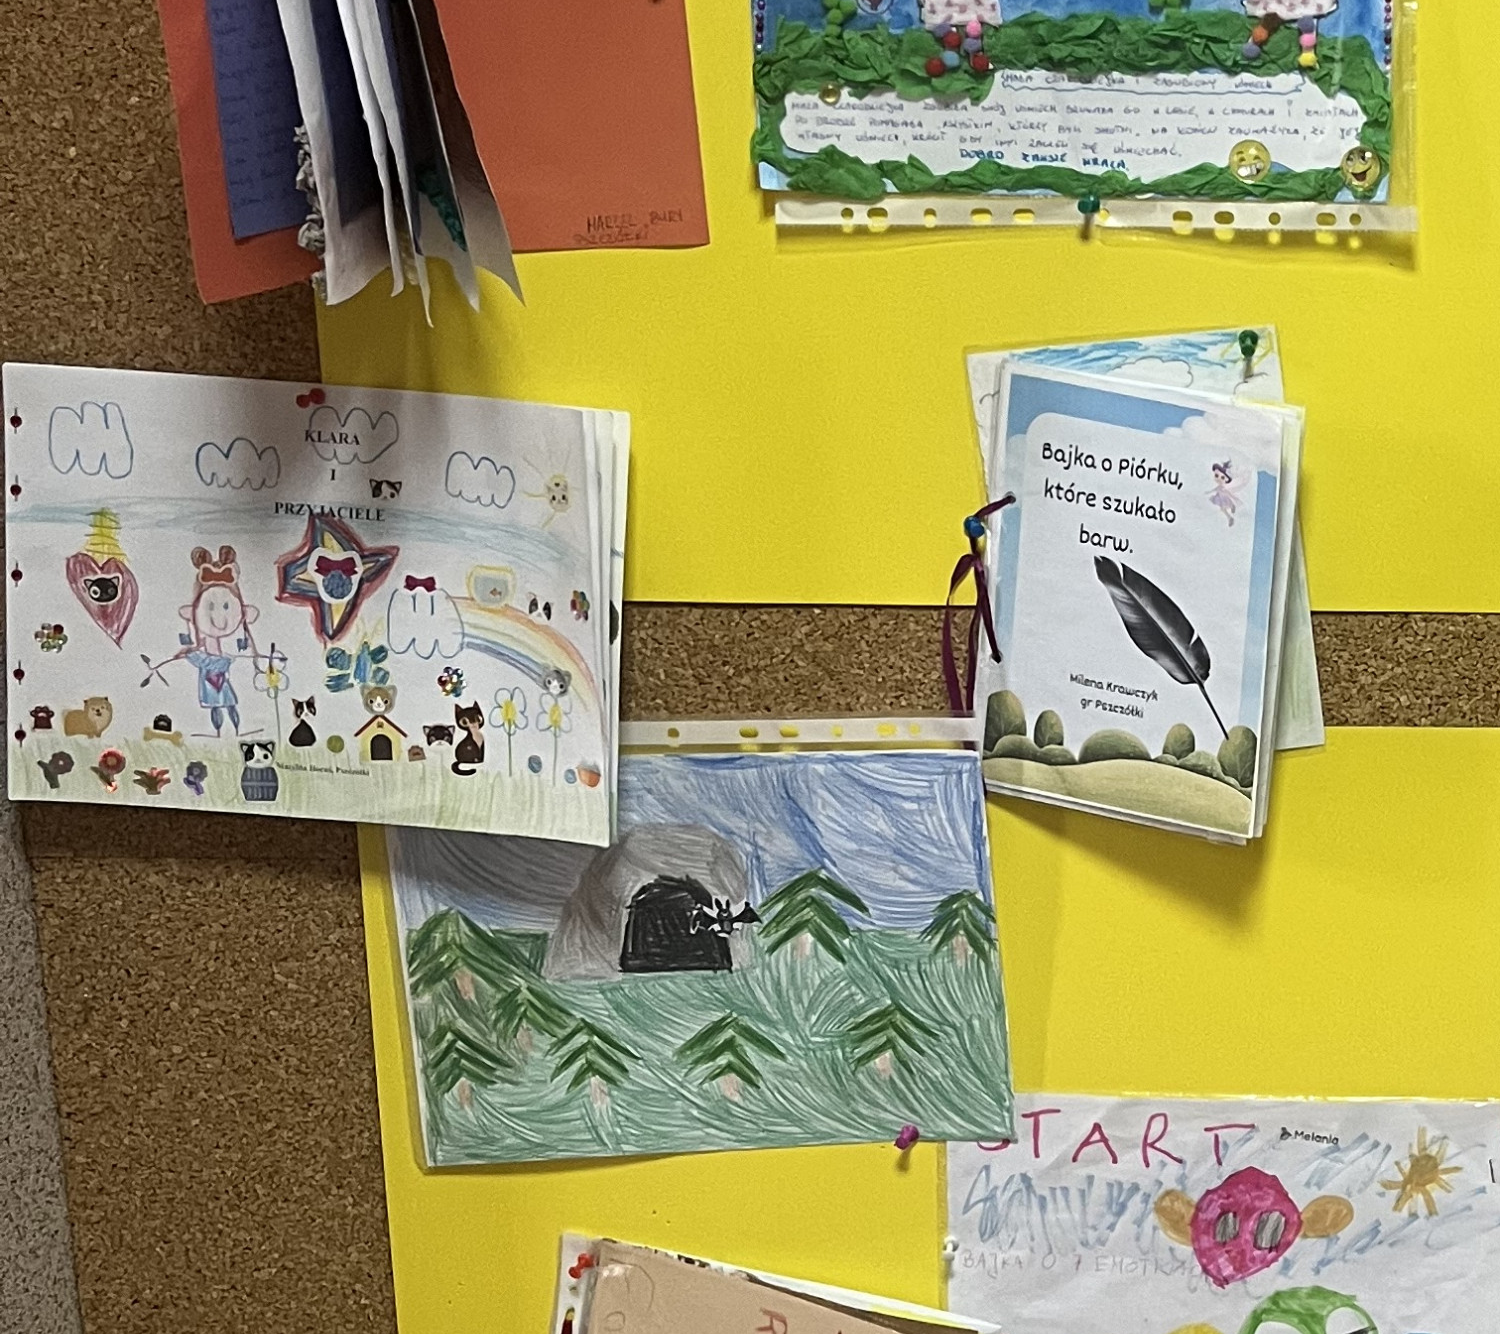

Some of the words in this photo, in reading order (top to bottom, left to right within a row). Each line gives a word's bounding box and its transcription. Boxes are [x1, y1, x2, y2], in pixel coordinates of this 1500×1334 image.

[304, 429, 361, 447] KLARA
[330, 469, 336, 481] I
[1042, 442, 1097, 470] Bajka
[1101, 458, 1112, 472] o
[1119, 456, 1183, 489] Piórku,
[274, 501, 386, 522] PRZYJACIELE
[1044, 478, 1097, 508] które
[1103, 494, 1176, 524] szukało
[1079, 524, 1134, 554] barw.
[1070, 673, 1104, 690] Milena
[1106, 682, 1158, 702] Krawczyk
[1080, 698, 1092, 709] gr
[1095, 699, 1143, 718] Pszczółki
[962, 1250, 1024, 1279] BAJKA
[1042, 1253, 1056, 1269] O
